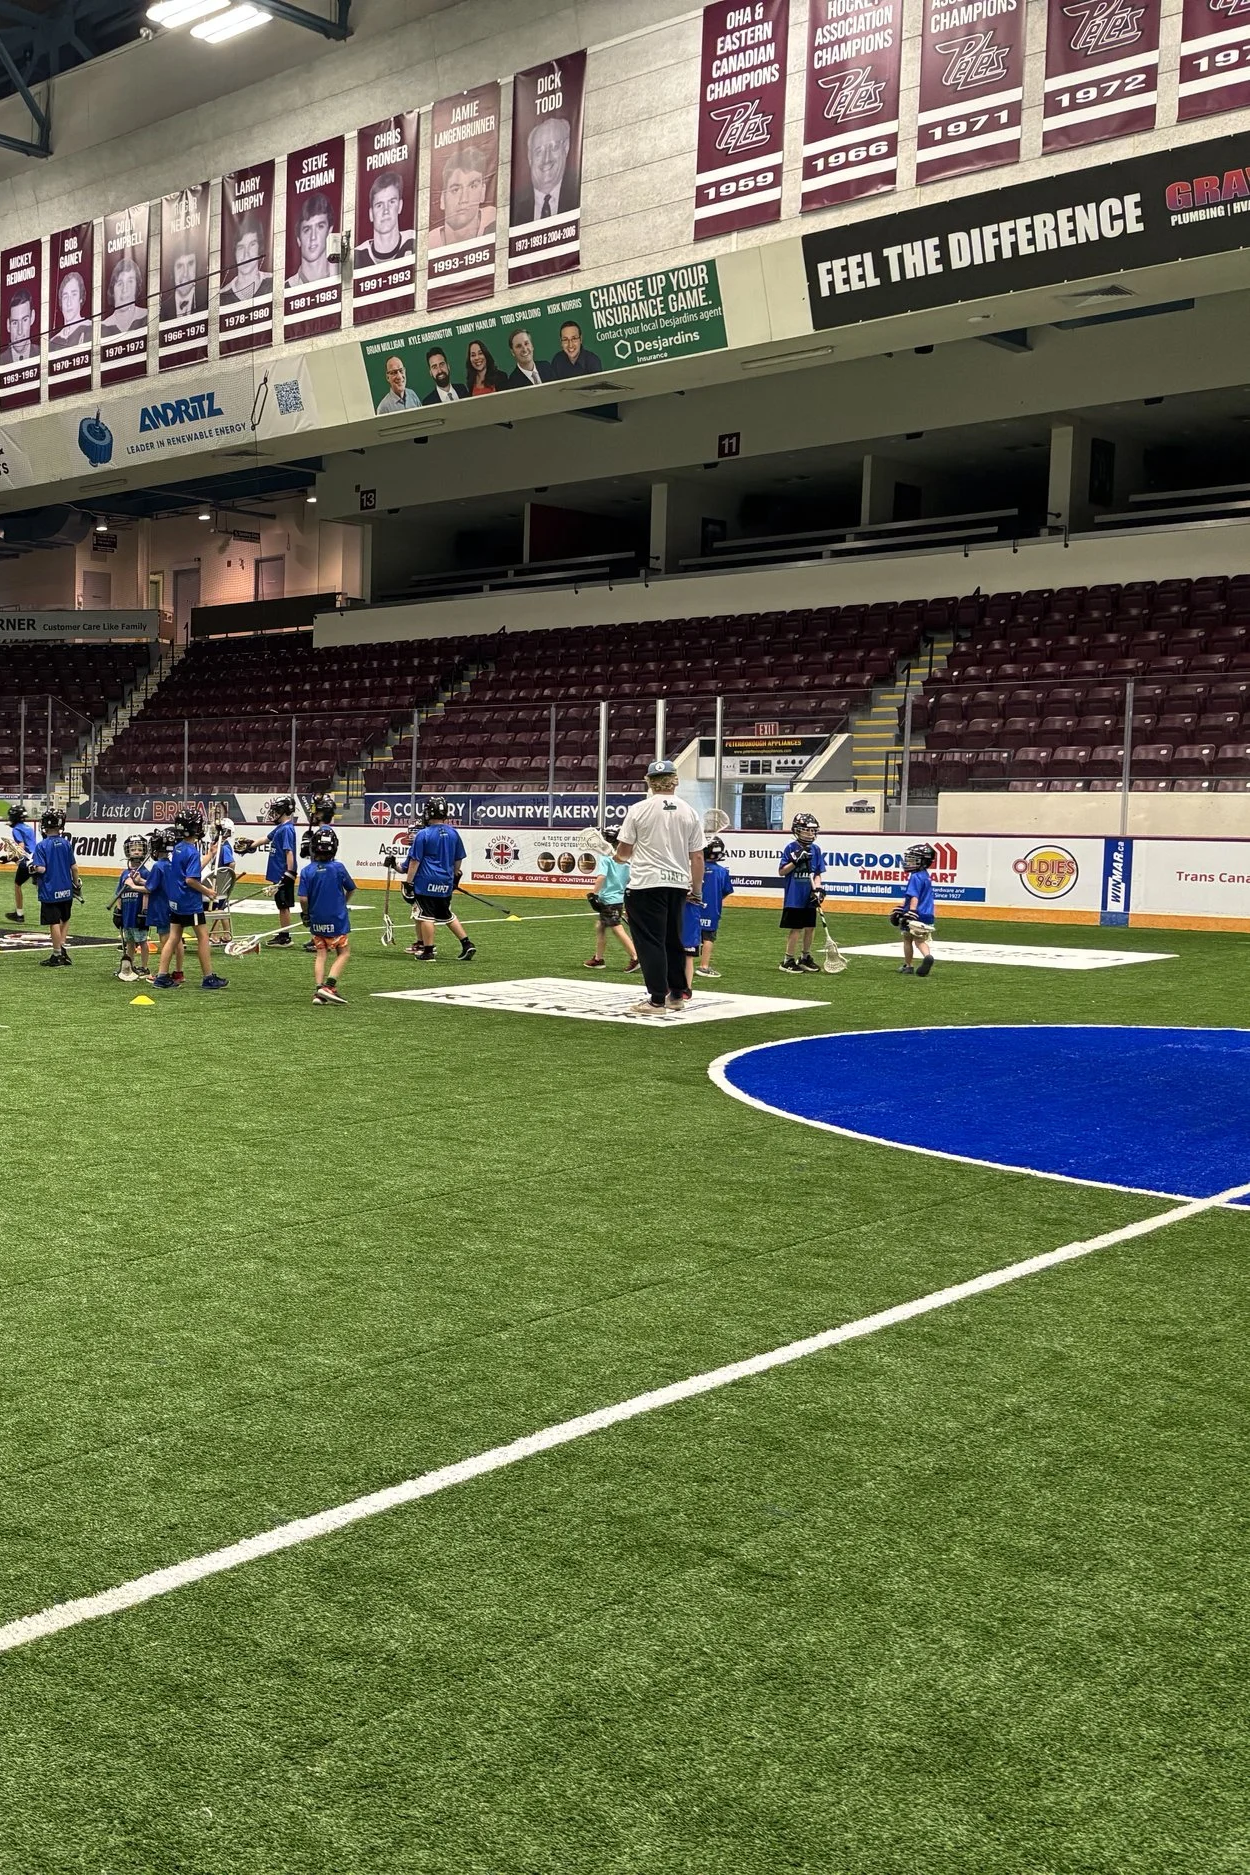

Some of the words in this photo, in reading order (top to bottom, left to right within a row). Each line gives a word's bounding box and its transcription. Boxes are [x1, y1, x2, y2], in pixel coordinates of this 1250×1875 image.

[726, 11, 752, 30] OHA
[754, 2, 764, 21] &
[814, 5, 894, 47] ASSOCIATION
[930, 0, 1017, 34] CHAMPIONS
[716, 21, 773, 56] EASTERN
[813, 29, 894, 70] CHAMPIONS
[712, 43, 776, 79] CANADIAN
[537, 71, 562, 95] DICK
[706, 64, 780, 102] CHAMPIONS
[1054, 74, 1147, 108] 1972
[450, 100, 479, 125] JAMIE
[535, 92, 563, 116] TODD
[434, 115, 495, 149] LANGENBRUNNER
[928, 110, 1009, 141] 1971
[374, 128, 401, 150] CHRIS
[302, 152, 329, 174] STEVE
[366, 144, 409, 172] PRONGER
[812, 141, 889, 172] 1966
[235, 175, 260, 197] LARRY
[295, 168, 335, 194] YZERMAN
[703, 172, 775, 200] 1959
[1165, 167, 1250, 212] GRA
[231, 192, 265, 215] MURPHY
[115, 217, 136, 236] COLIN
[170, 212, 200, 234] NEILSON
[1170, 205, 1225, 227] PLUMBING
[64, 236, 78, 253] BOB
[107, 231, 144, 254] CAMPBELL
[515, 237, 542, 252] 1973-1993
[547, 225, 576, 244] 2004-2006
[817, 252, 882, 297] FEEL
[883, 236, 944, 279] THE
[947, 193, 1145, 271] DIFFERENCE
[9, 252, 33, 271] MICKEY
[59, 250, 83, 270] GAINEY
[432, 249, 490, 274] 1993-1995
[6, 266, 36, 287] REDMOND
[359, 270, 412, 293] 1991-1993
[590, 279, 645, 310] CHANGE
[647, 274, 666, 297] UP
[668, 264, 709, 292] YOUR
[289, 289, 338, 311] 1981-1983
[547, 304, 561, 315] KIRK
[561, 298, 583, 312] NORRIS
[592, 296, 666, 330] INSURANCE
[667, 287, 712, 313] GAME.
[224, 307, 270, 327] 1978-1980
[455, 324, 475, 336] TAMMY
[475, 317, 497, 332] HANLON
[500, 313, 515, 325] TODD
[515, 307, 542, 323] SPALDING
[596, 327, 623, 342] Contact
[624, 325, 640, 339] your
[640, 320, 659, 333] local
[660, 310, 699, 329] Desjardins
[700, 305, 722, 322] agent
[163, 324, 206, 343] 1966-1976
[408, 334, 421, 346] KYLE
[421, 327, 453, 344] HARRINGTON
[634, 331, 700, 353] Desjardins
[104, 340, 145, 358] 1970-1973
[381, 338, 405, 353] MULLIGAN
[52, 354, 89, 372] 1970-1973
[637, 352, 668, 363] Insurance
[3, 368, 38, 386] 1963-1967
[139, 391, 225, 433] ANDRITZ
[126, 443, 155, 455] LEADER
[156, 439, 165, 449] IN
[166, 429, 214, 447] RENEWABLE
[214, 422, 247, 437] ENERGY
[722, 437, 738, 454] 11
[361, 493, 375, 508] 13
[42, 623, 83, 632] Customer
[84, 624, 101, 632] Care
[102, 623, 119, 632] Like
[120, 622, 148, 632] Family
[759, 725, 775, 736] EXIT
[725, 740, 767, 748] PETERBOROUGH
[767, 739, 802, 747] APPLIANCES
[86, 802, 98, 818] A
[101, 803, 139, 818] taste
[140, 800, 150, 821] of
[1012, 859, 1076, 875] OLDIES
[1176, 871, 1215, 883] Trans
[859, 885, 893, 895] Lakefield
[312, 923, 335, 933] CAMPER
